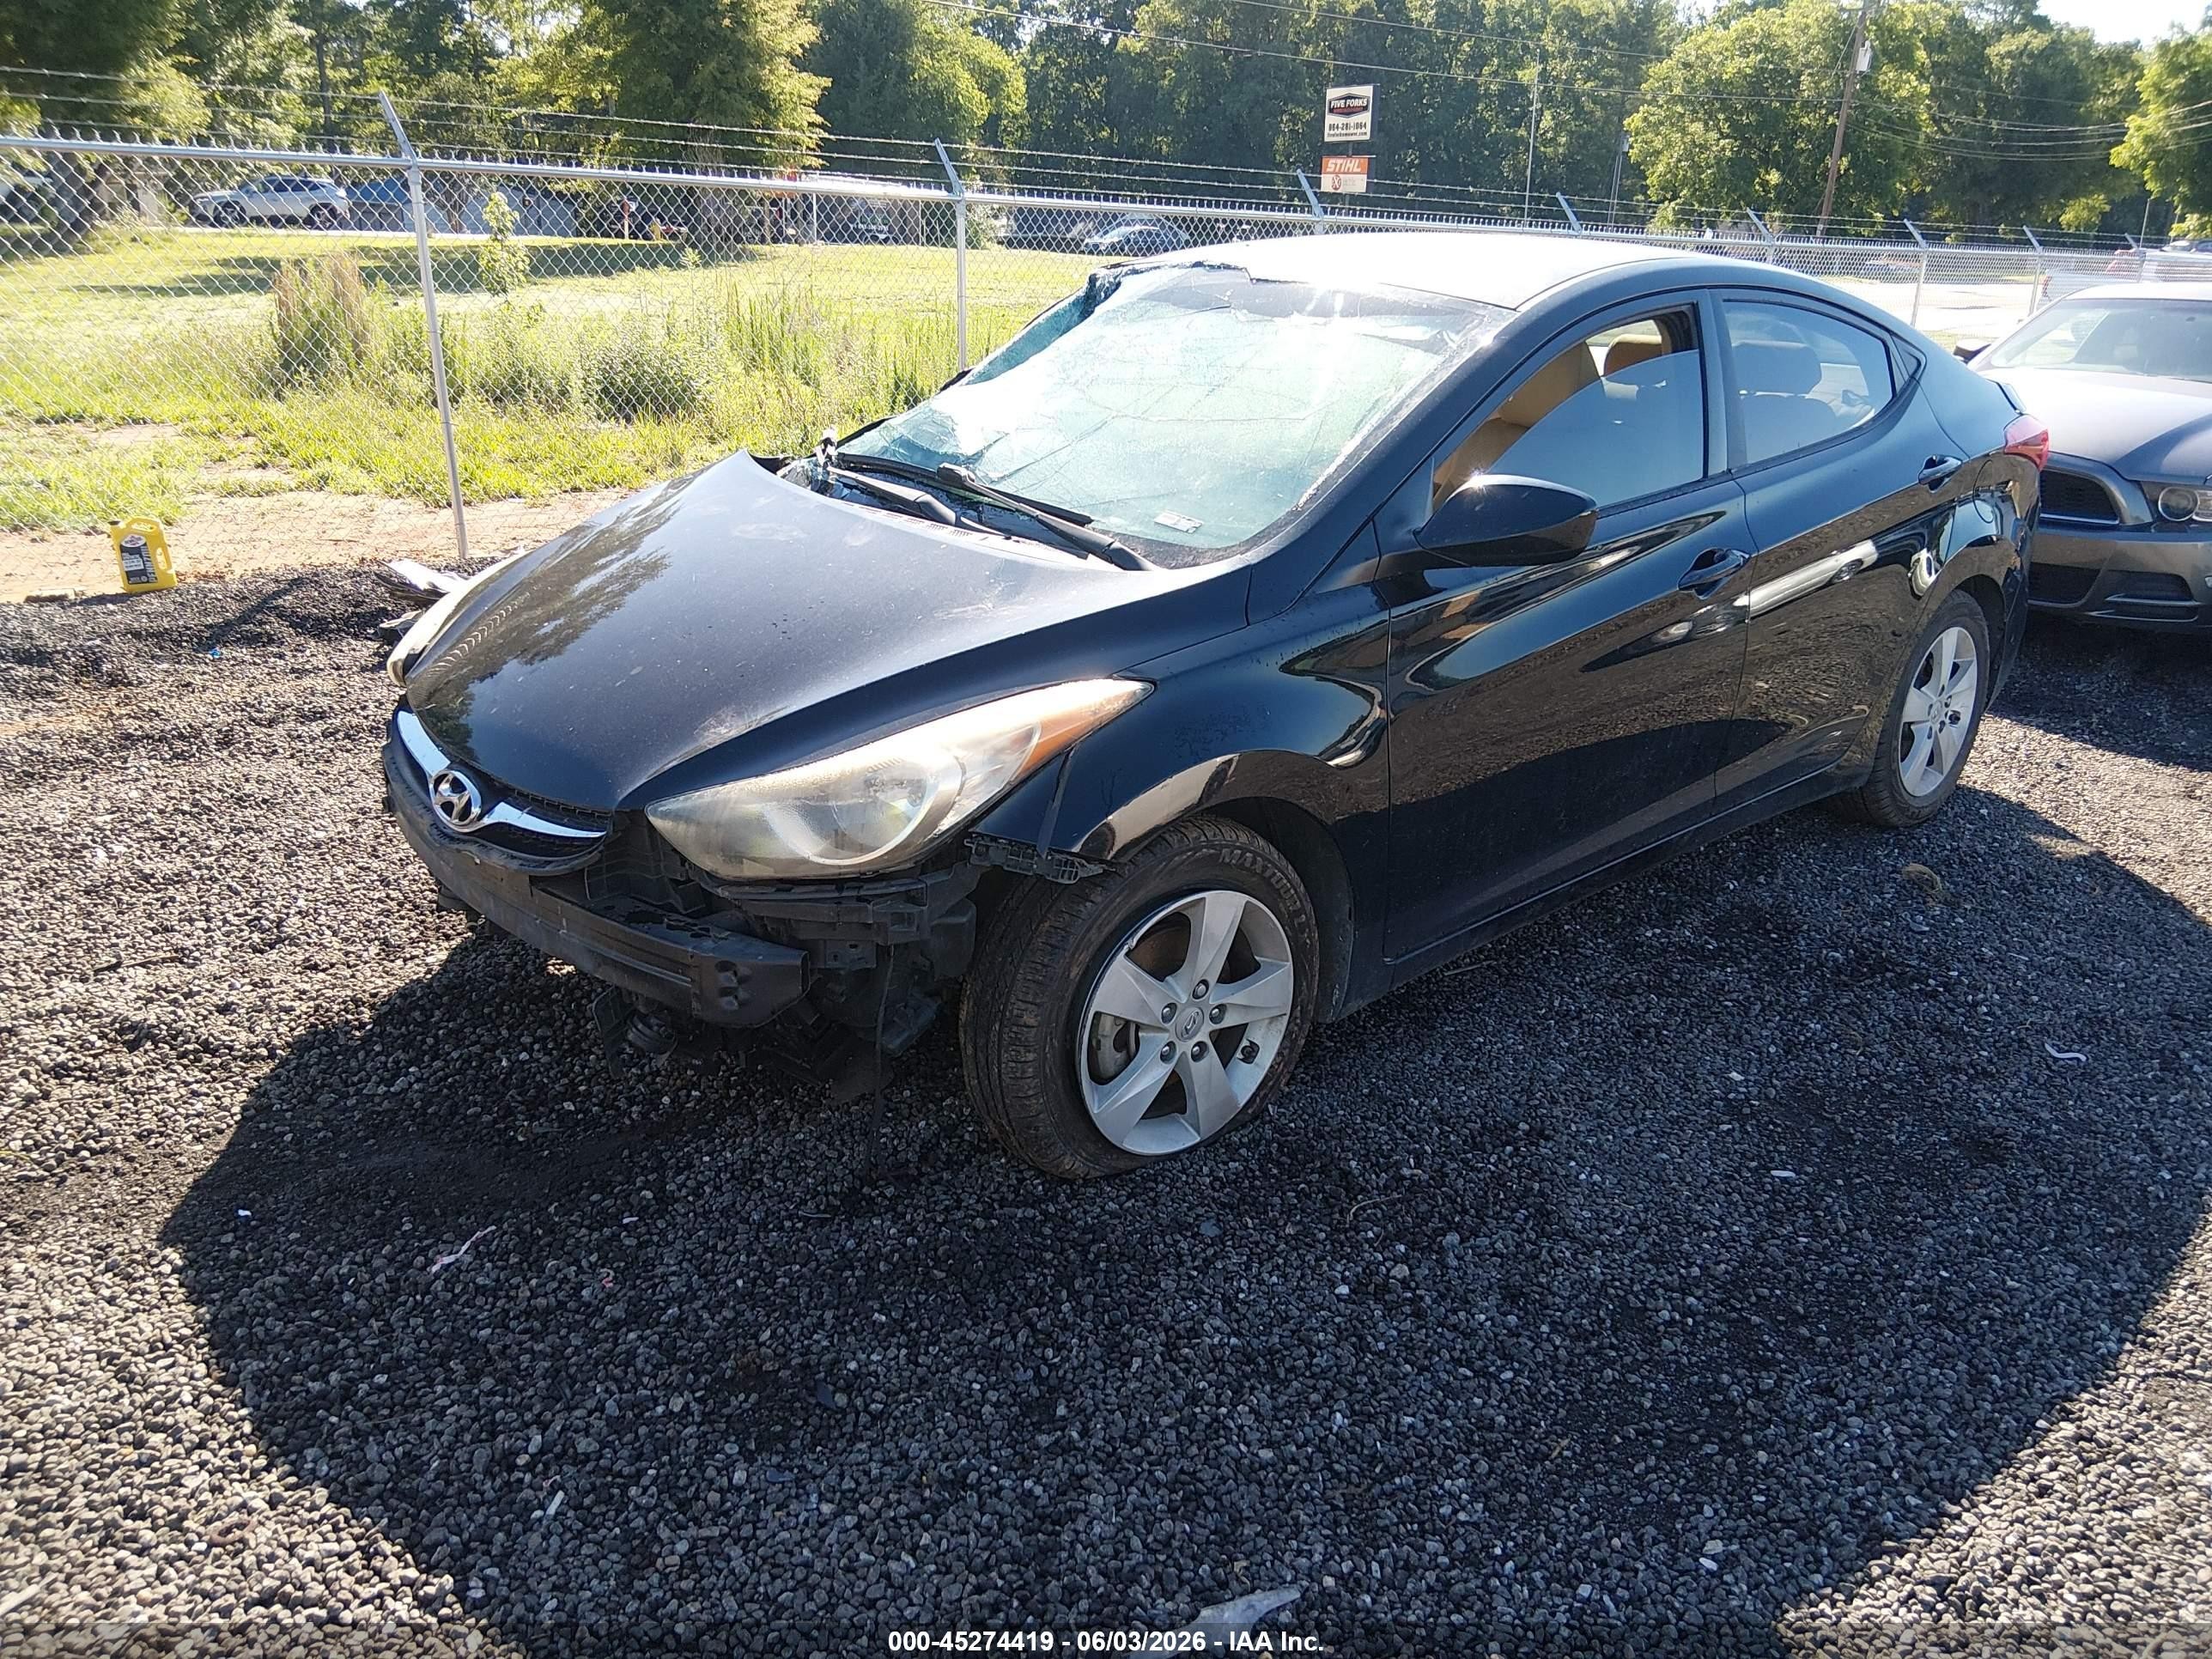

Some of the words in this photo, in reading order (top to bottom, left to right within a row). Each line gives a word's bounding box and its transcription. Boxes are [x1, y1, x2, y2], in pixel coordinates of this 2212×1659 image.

[1331, 100, 1346, 108] FIVE
[1346, 98, 1367, 107] FORKS
[1326, 159, 1362, 173] STIHL
